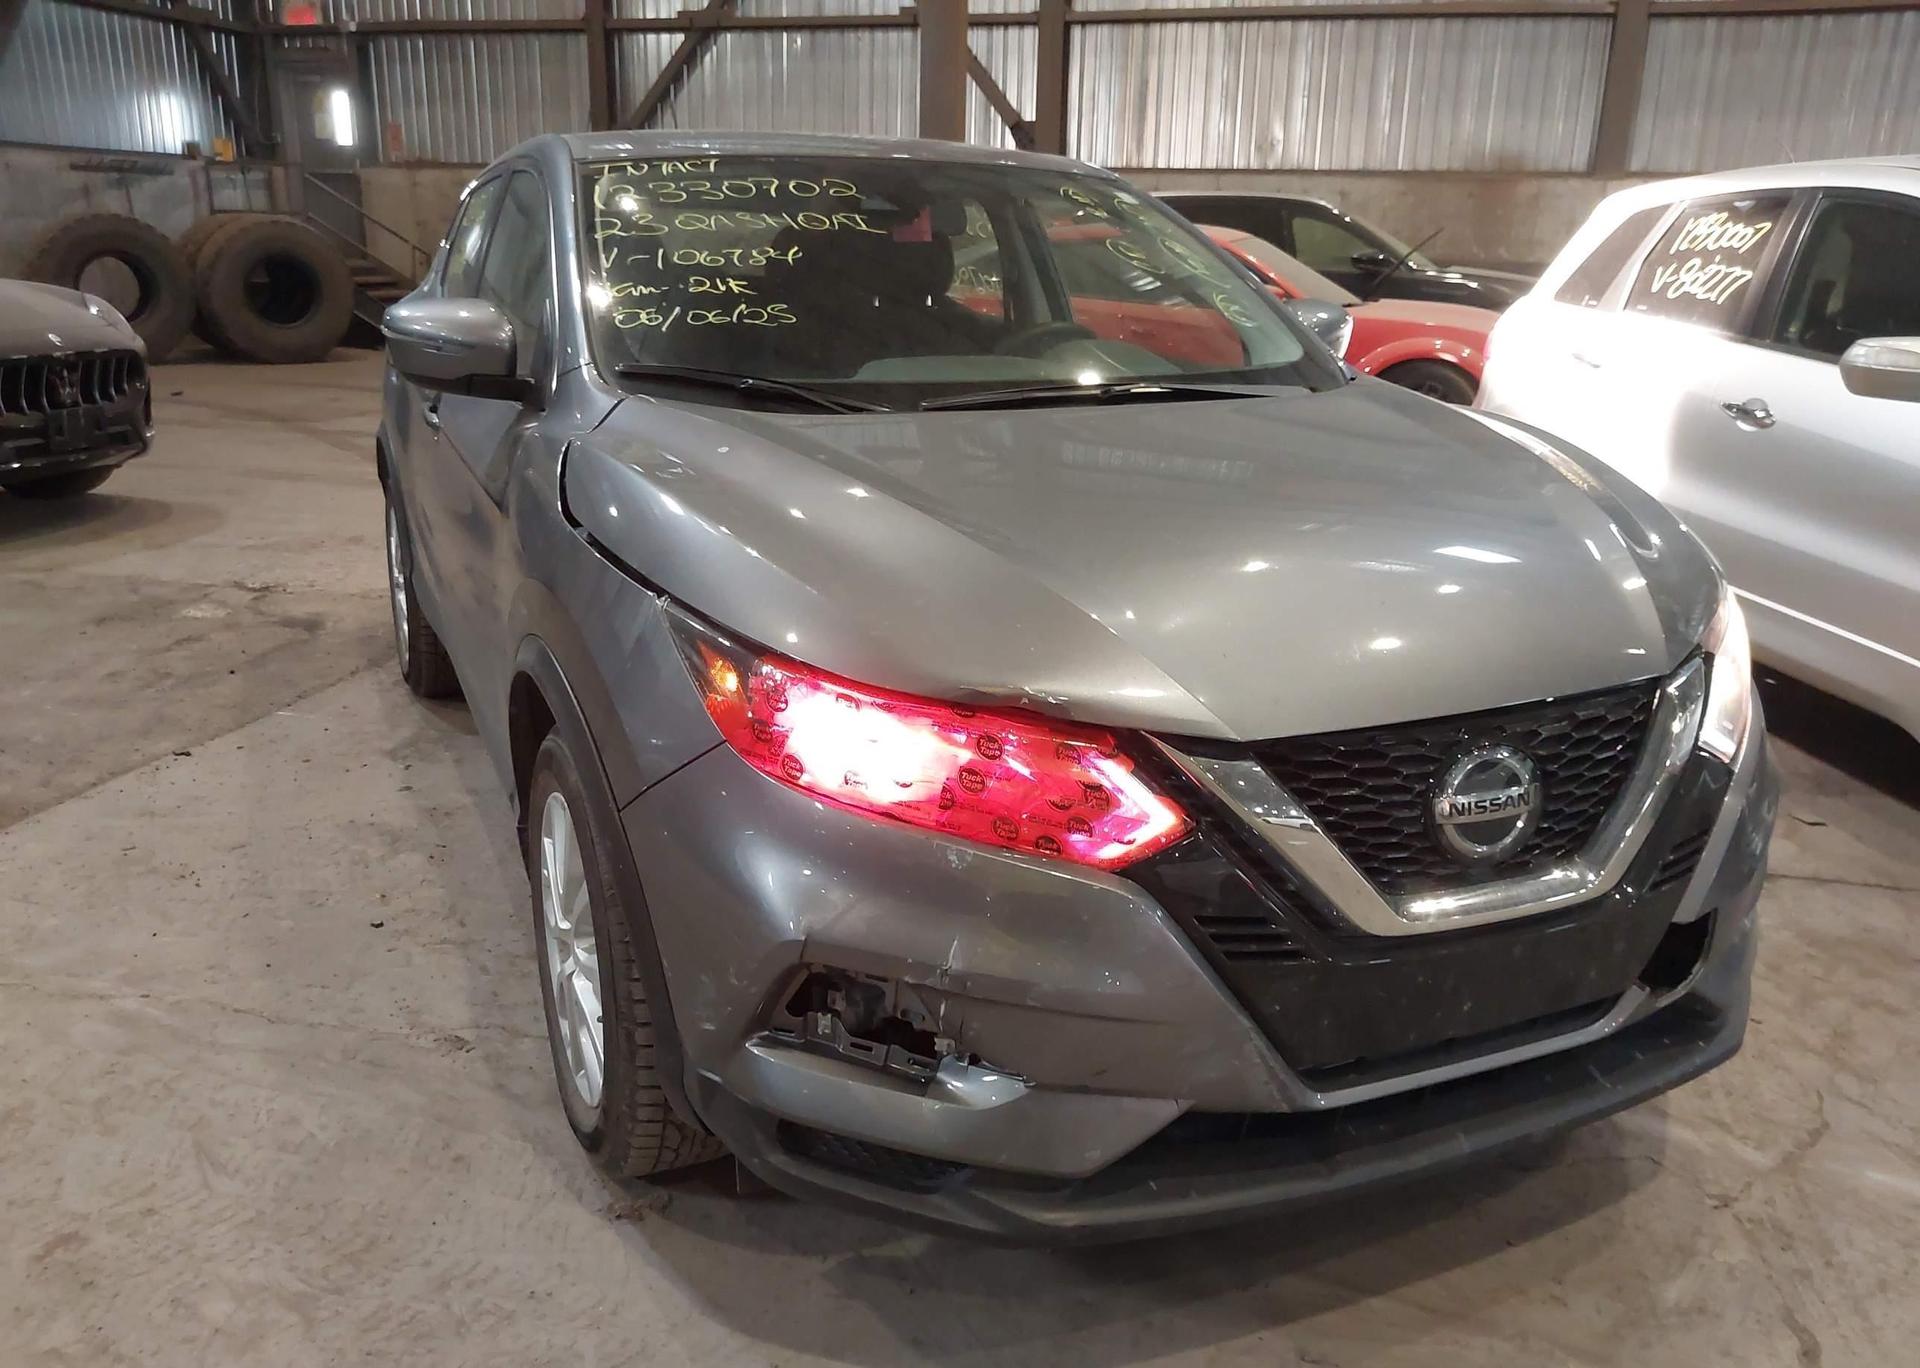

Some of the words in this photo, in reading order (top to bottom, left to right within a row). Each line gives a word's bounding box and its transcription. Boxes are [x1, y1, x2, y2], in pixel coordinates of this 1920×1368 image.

[979, 738, 1000, 751] Tuck
[980, 747, 1001, 760] Tape
[784, 757, 801, 769] Tuck
[784, 766, 802, 778] Tape
[961, 771, 983, 783] Tuck
[961, 780, 984, 792] Tape
[1449, 793, 1530, 817] NISSAN
[994, 820, 1017, 832] Tuck
[995, 828, 1018, 840] Tape
